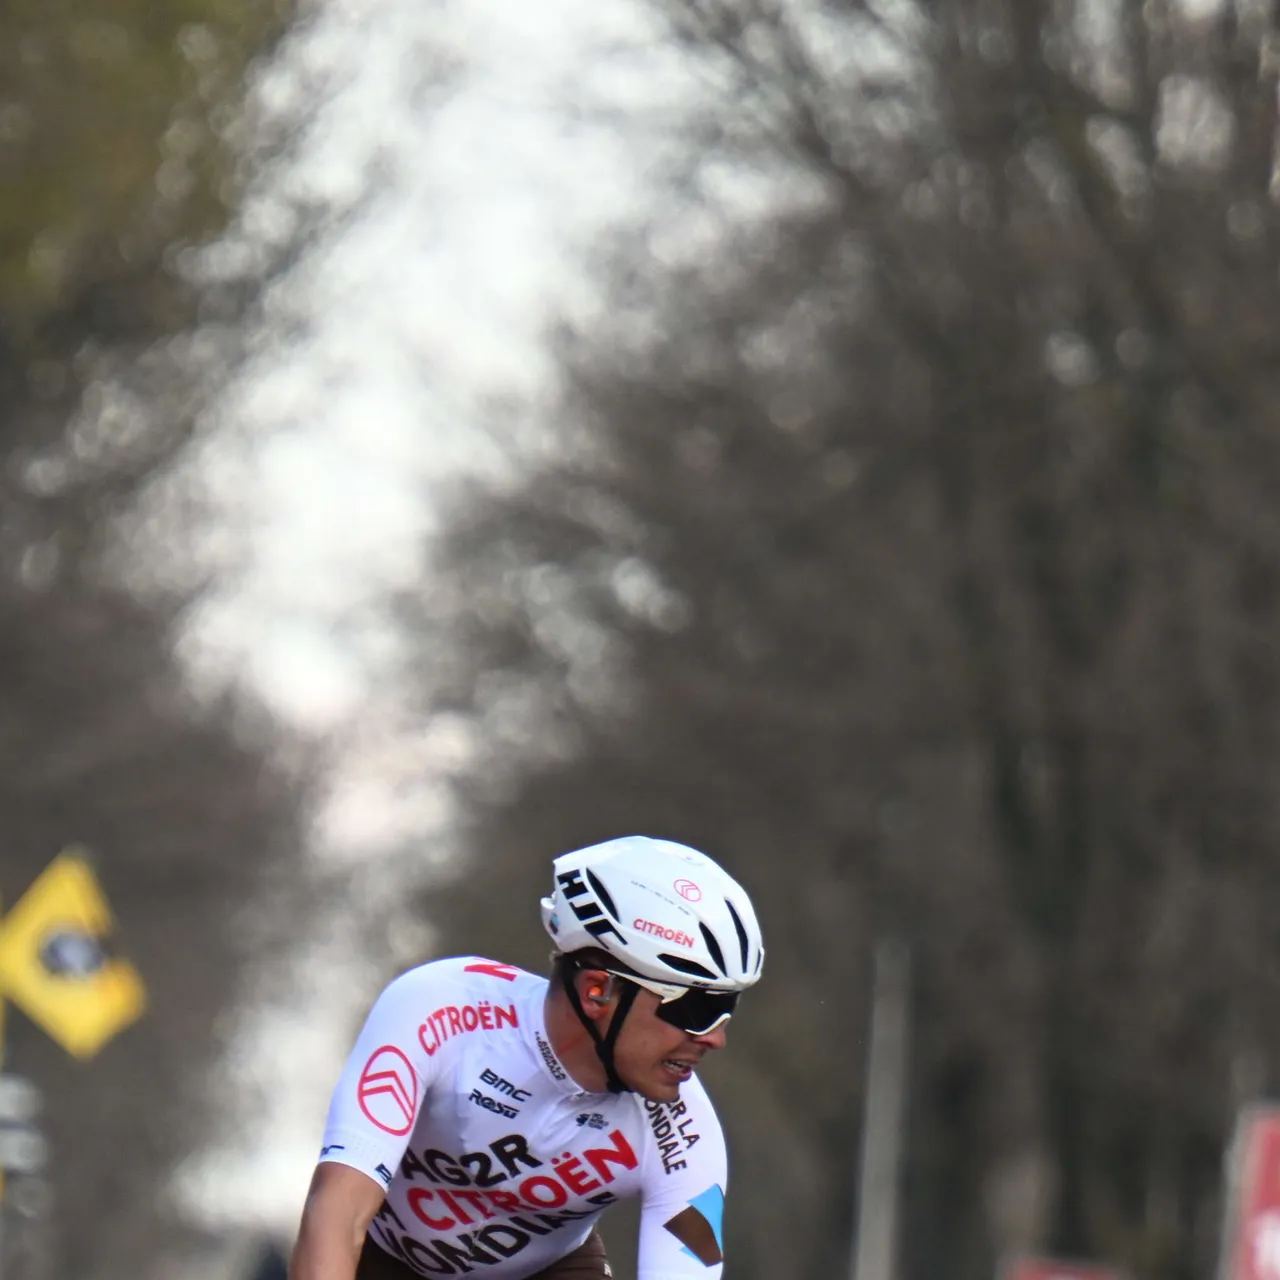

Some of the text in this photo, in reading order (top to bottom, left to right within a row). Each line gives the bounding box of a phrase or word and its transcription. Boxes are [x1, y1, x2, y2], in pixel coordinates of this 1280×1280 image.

[557, 869, 628, 949] HJC
[633, 918, 695, 949] CITROËN
[417, 1001, 519, 1057] CITROËN
[479, 1068, 533, 1102] BMC
[401, 1134, 544, 1188] AG2R
[644, 1098, 688, 1175] ONDIALE
[677, 1118, 701, 1149] LA
[407, 1129, 638, 1231] CITROËN
